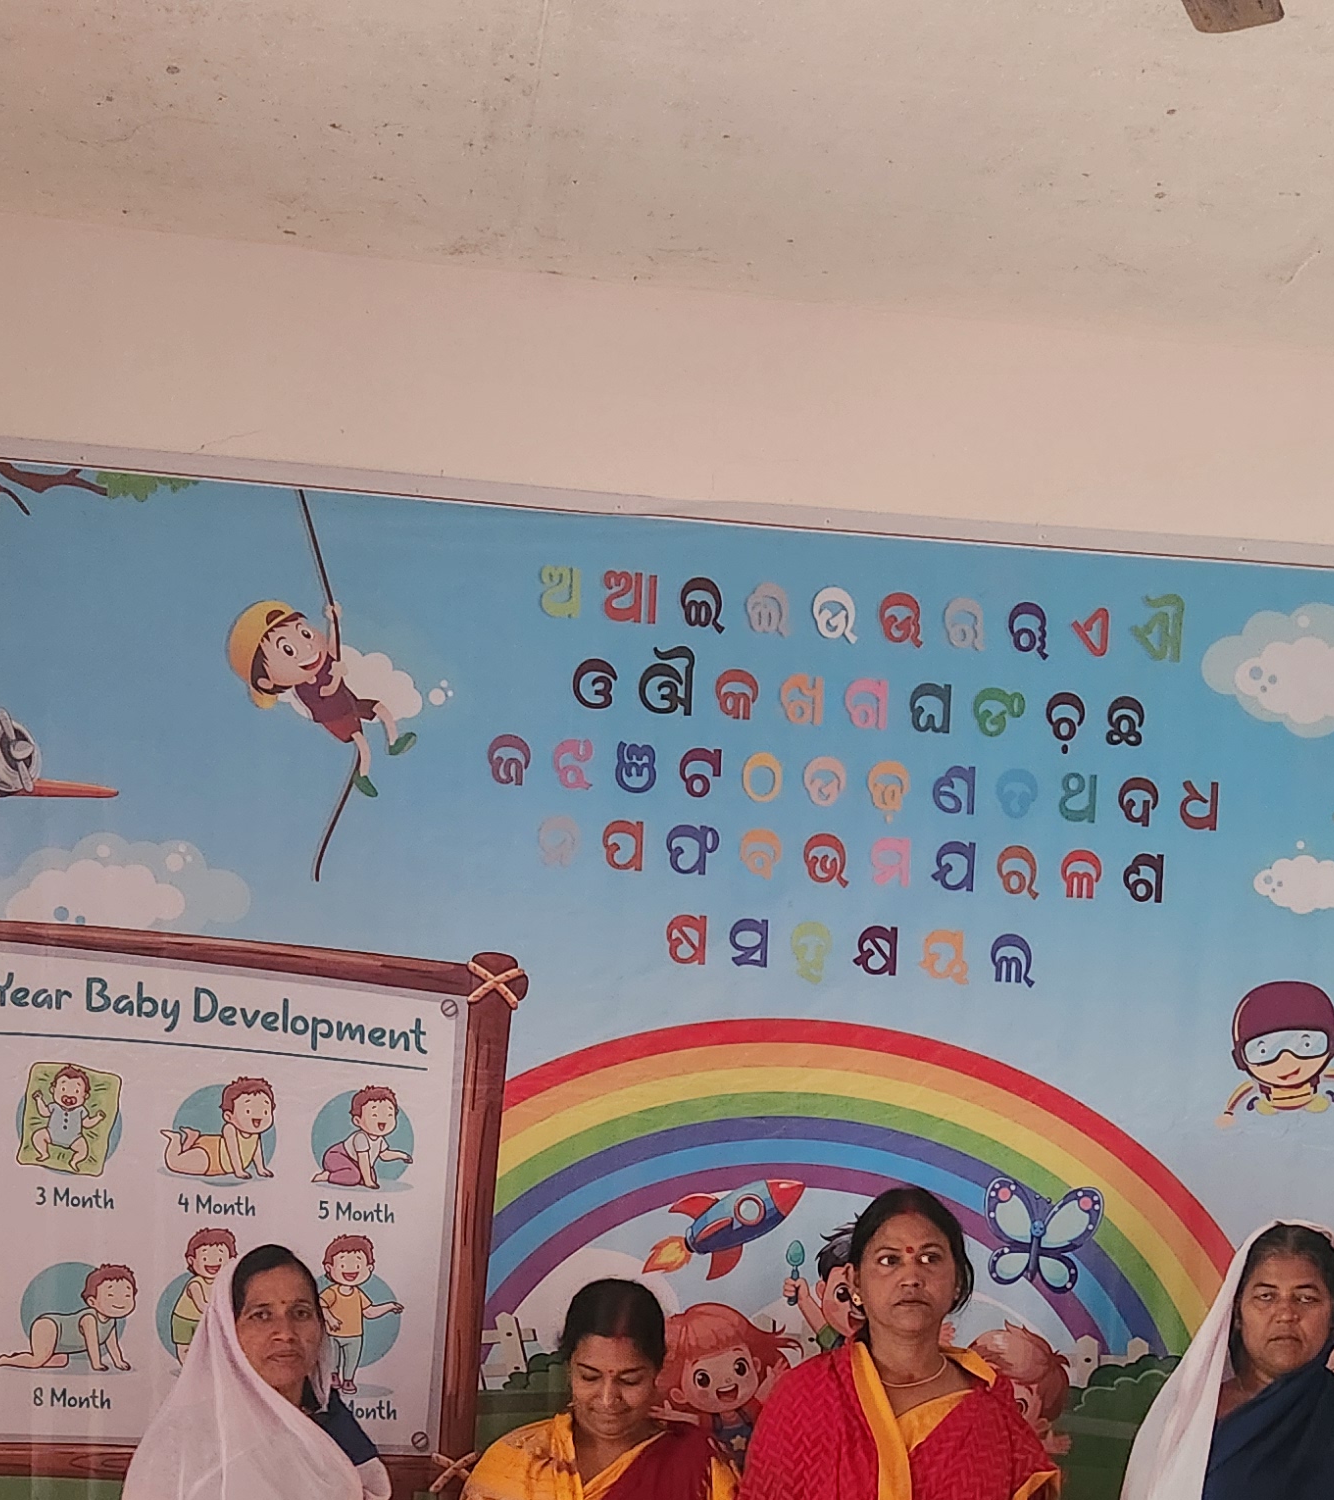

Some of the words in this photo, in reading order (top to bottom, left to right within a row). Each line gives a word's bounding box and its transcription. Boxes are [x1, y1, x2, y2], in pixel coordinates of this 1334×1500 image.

[540, 565, 581, 618] ଅ
[603, 570, 658, 624] ଆ
[680, 576, 725, 634] ଇ
[813, 586, 858, 644] ଉ
[879, 592, 923, 648] ଊ
[1071, 607, 1109, 657] ଏ
[1130, 593, 1184, 663] ଐ
[572, 658, 618, 709] ଓ
[639, 645, 695, 716] ଔ
[716, 668, 759, 720] କ
[780, 673, 824, 726] ଖ
[844, 677, 889, 731] ଗ
[909, 682, 952, 734] ଘ
[973, 687, 1026, 737] ଙ
[1105, 695, 1145, 747] ଛ
[487, 733, 531, 786] ଜ
[553, 739, 594, 791] ଝ
[615, 740, 657, 794] ଞ
[679, 747, 723, 798] ଟ
[741, 750, 783, 803] ଠ
[802, 755, 847, 807] ଡ
[932, 765, 976, 815] ଣ
[995, 768, 1038, 819] ତ
[1058, 772, 1098, 824] ଥ
[1117, 776, 1159, 828] ଦ
[1179, 779, 1219, 832] ଧ
[602, 819, 644, 872] ପ
[666, 824, 720, 876] ଫ
[740, 827, 782, 880] ବ
[803, 832, 850, 889] ଭ
[870, 836, 911, 888] ମ
[931, 840, 976, 893] ଯ
[996, 845, 1039, 900] ର
[1061, 849, 1102, 900] ଳ
[1123, 853, 1164, 903] ଶ
[666, 914, 707, 966] ଷ
[729, 918, 769, 968] ସ
[990, 933, 1036, 988] ଲ
[85, 977, 182, 1033] Baby
[193, 987, 429, 1057] Development
[35, 1186, 48, 1207] 3
[53, 1187, 115, 1211] Month
[177, 1194, 192, 1216] 4
[195, 1195, 257, 1219] Month
[317, 1201, 331, 1221] 5
[335, 1202, 396, 1226] Month
[32, 1387, 45, 1408] 8
[49, 1388, 113, 1412] Month
